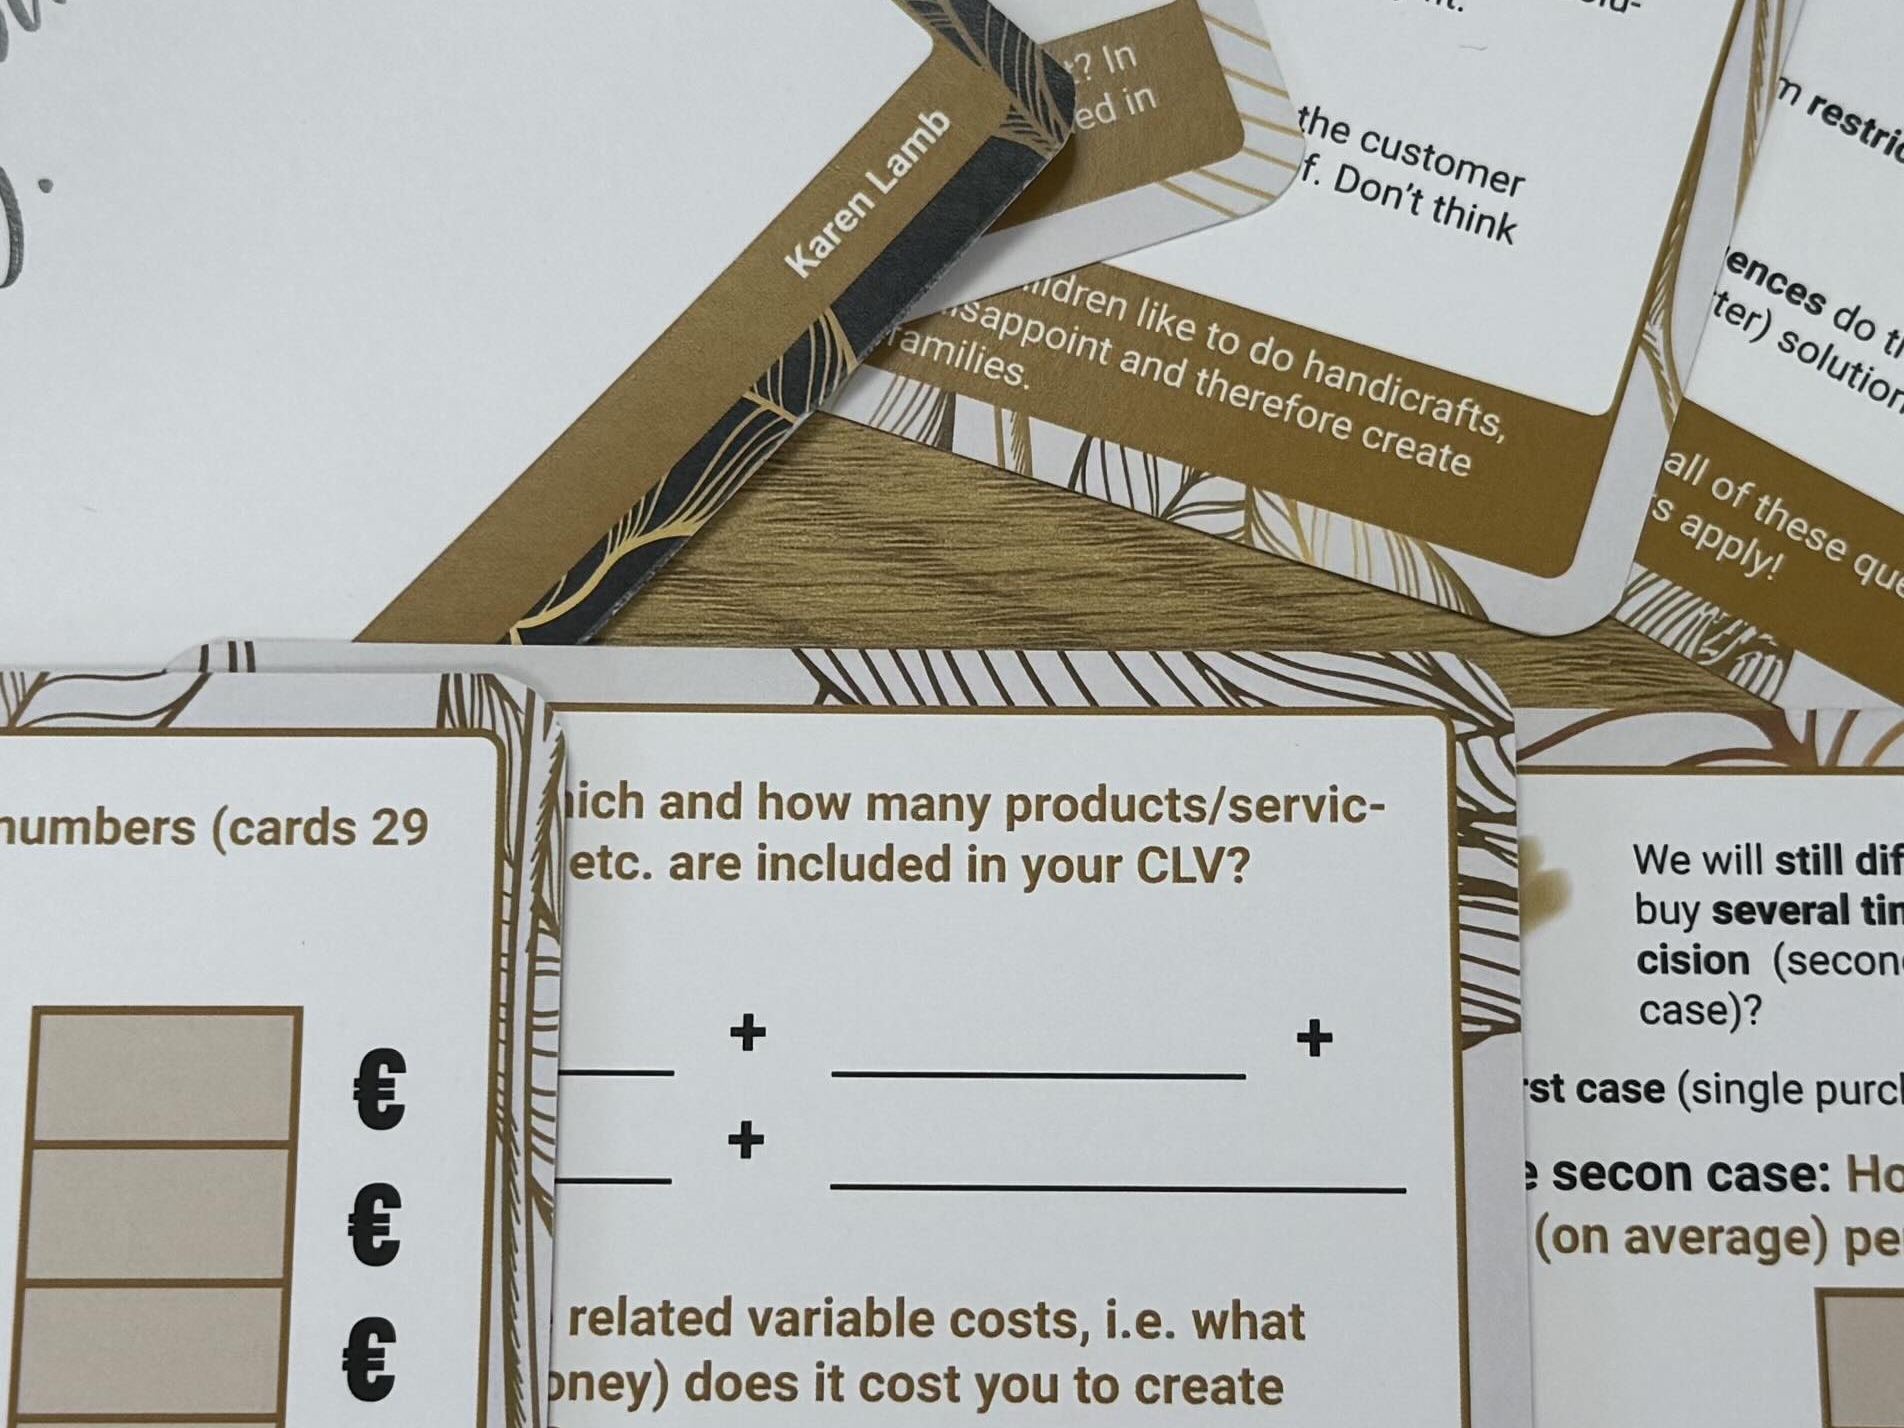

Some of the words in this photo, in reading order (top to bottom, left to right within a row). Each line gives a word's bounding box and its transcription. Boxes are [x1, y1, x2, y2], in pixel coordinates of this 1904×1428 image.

[783, 191, 876, 279] Karen
[864, 110, 951, 195] Lamb
[1136, 296, 1196, 342] like
[1206, 322, 1240, 355] to
[1249, 336, 1294, 372] do
[1302, 348, 1505, 445] handicrafts,
[1663, 452, 1710, 486] all
[1711, 477, 1756, 508] of
[1754, 494, 1848, 562] these
[212, 804, 357, 856] (cards
[372, 807, 428, 846] 29
[568, 844, 652, 881] etc.
[669, 851, 742, 882] are
[757, 842, 951, 883] included
[967, 843, 1006, 883] in
[1020, 854, 1124, 894] your
[1137, 845, 1251, 884] CLV?
[1632, 843, 1691, 876] We
[1702, 842, 1763, 876] will
[1775, 842, 1844, 876] still
